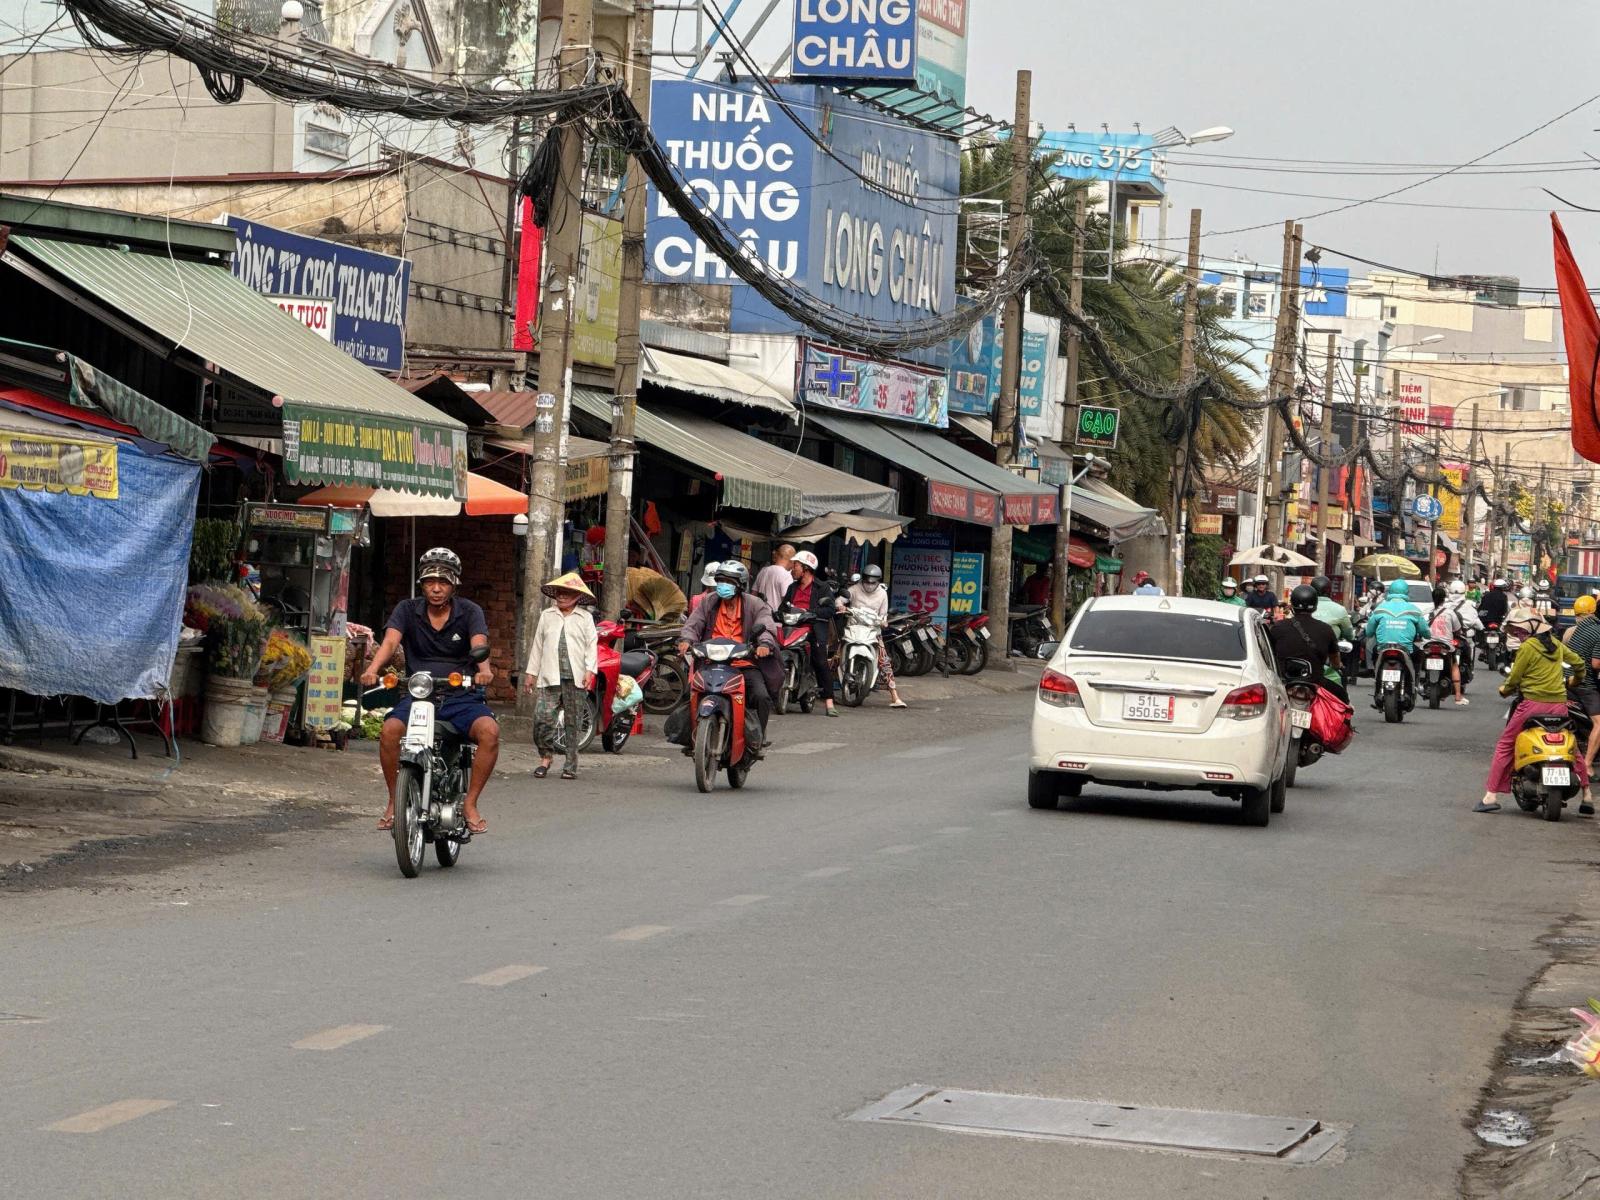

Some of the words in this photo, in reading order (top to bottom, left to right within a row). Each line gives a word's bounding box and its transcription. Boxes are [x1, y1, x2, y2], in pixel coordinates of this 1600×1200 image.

[801, 0, 910, 26] LONG
[797, 29, 911, 69] CHÂU
[692, 86, 771, 123] NHÀ
[666, 126, 794, 172] THUỐC
[1097, 144, 1143, 169] 315
[861, 140, 883, 193] NHÀ
[887, 144, 920, 206] THUỐC
[657, 180, 800, 222] LONG
[653, 229, 798, 278] CHÂU
[822, 204, 884, 297] LONG
[889, 218, 944, 314] CHÂU
[231, 224, 275, 293] CÔNG
[278, 249, 301, 294] TY
[337, 263, 385, 332] THẠCH
[876, 384, 890, 409] 35
[904, 389, 917, 415] 25
[1400, 394, 1422, 404] VÀNG
[1401, 383, 1422, 394] TIỆM
[1081, 410, 1115, 439] GẠO
[382, 428, 397, 462] HOA
[397, 426, 414, 465] TƯƠI
[1128, 706, 1168, 719] 950.65
[1138, 695, 1160, 707] 51L
